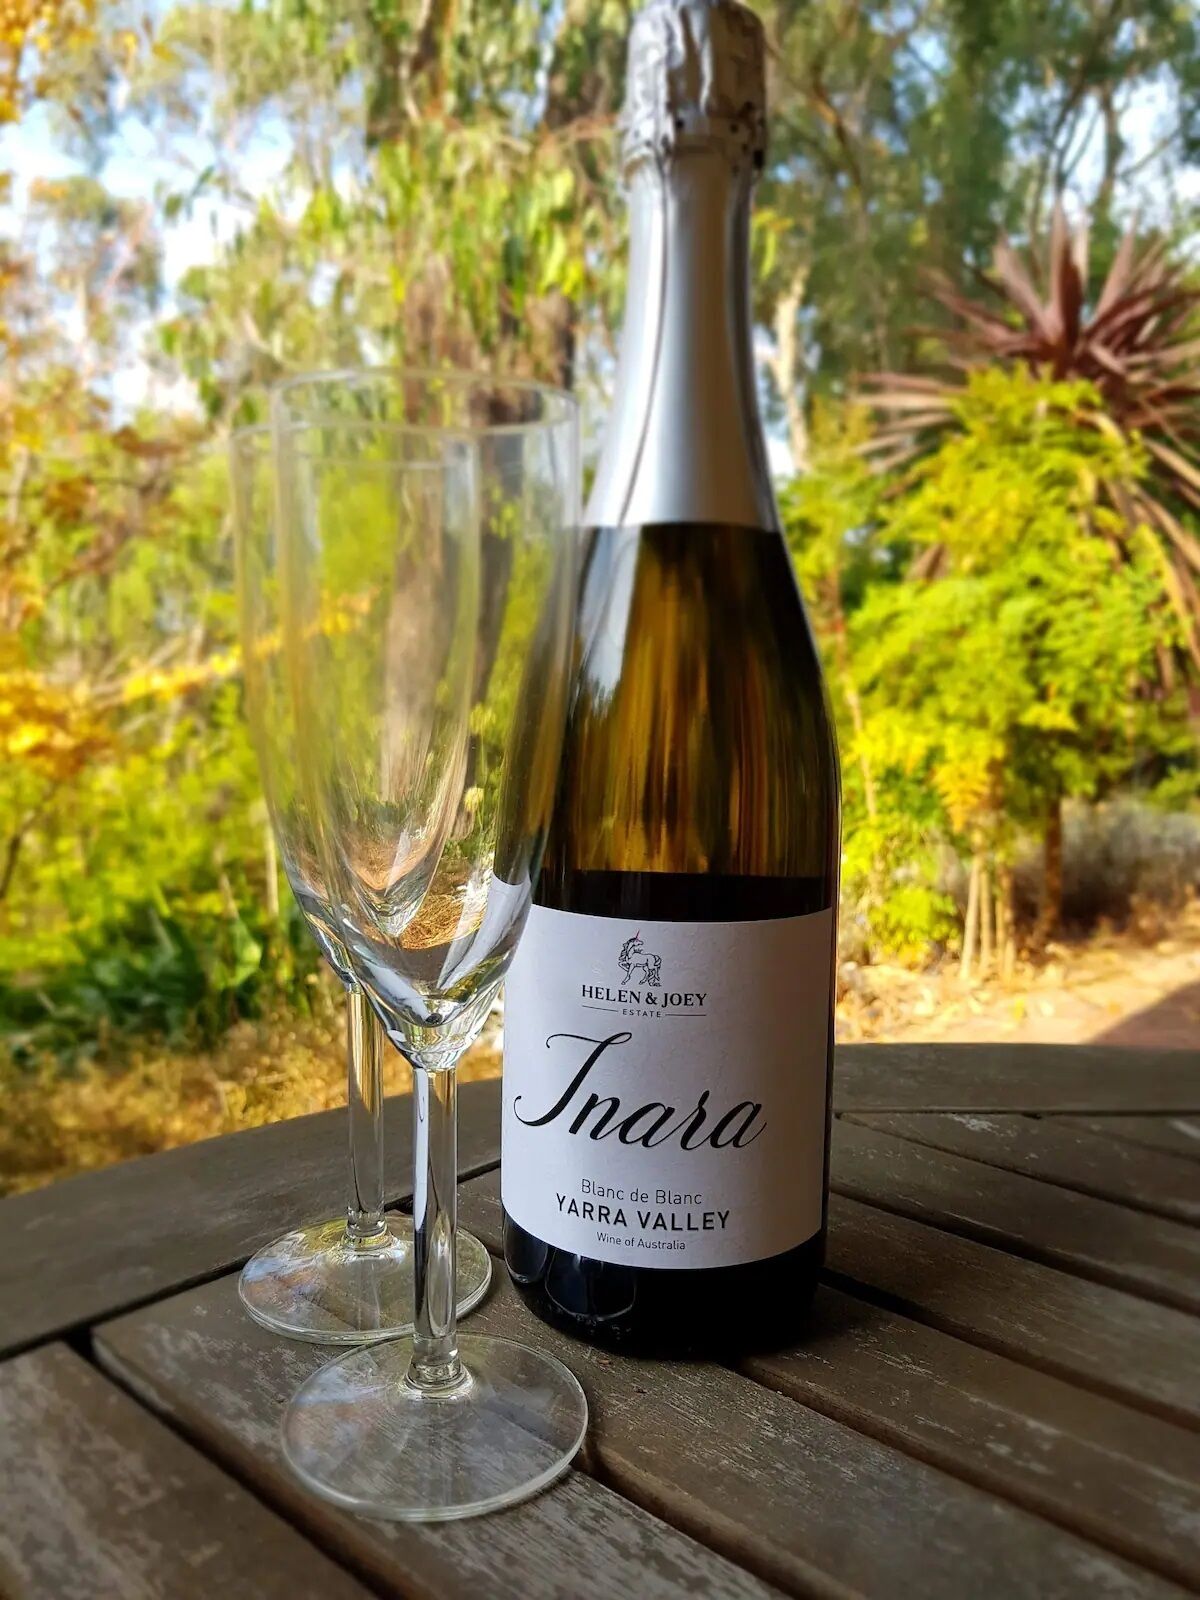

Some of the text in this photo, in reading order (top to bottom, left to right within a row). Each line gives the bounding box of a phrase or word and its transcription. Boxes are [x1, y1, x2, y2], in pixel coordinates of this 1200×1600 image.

[581, 984, 708, 1009] HELEN & JOEY
[622, 1008, 662, 1018] ESTATE
[513, 1031, 768, 1151] Inara
[581, 1178, 703, 1206] Blanc de Blanc
[555, 1192, 731, 1232] YARRA VALLEY
[596, 1231, 686, 1251] Wine of Australia
